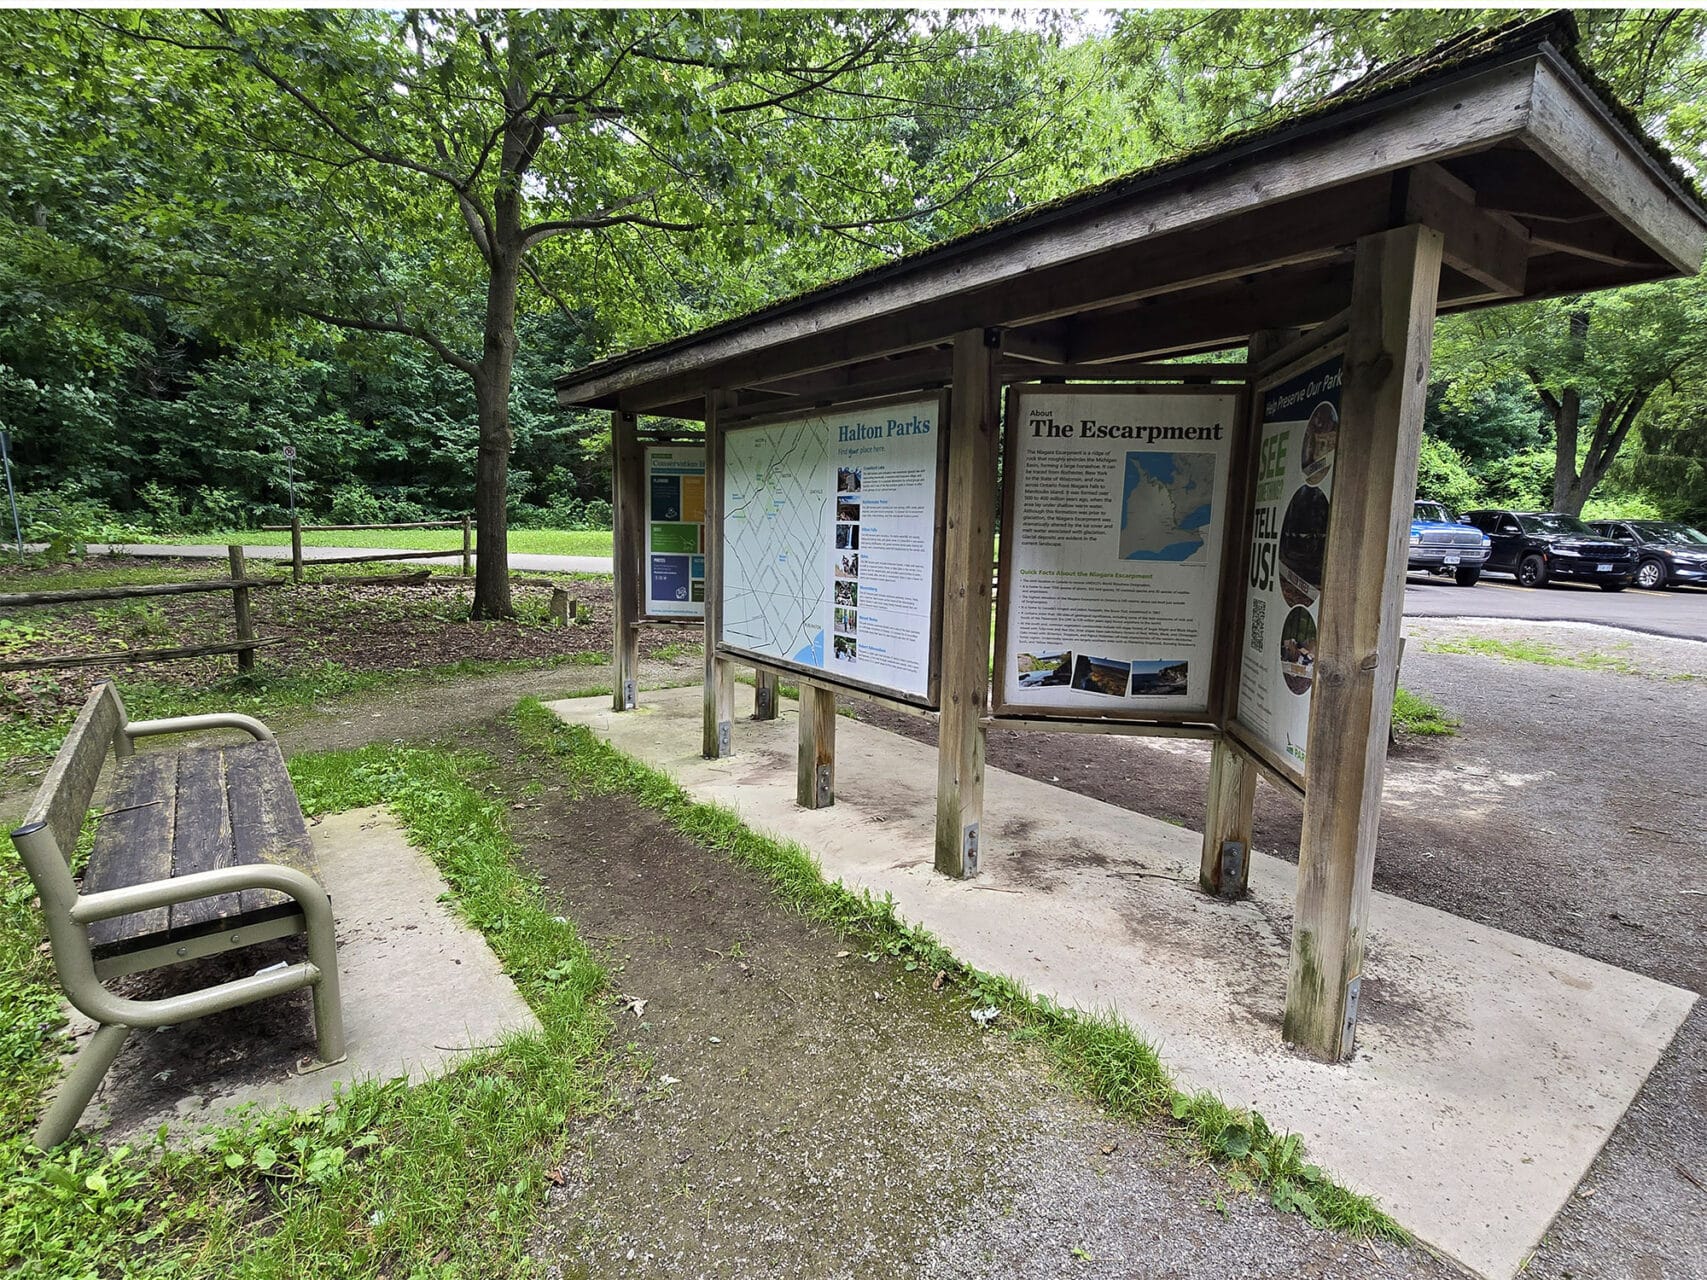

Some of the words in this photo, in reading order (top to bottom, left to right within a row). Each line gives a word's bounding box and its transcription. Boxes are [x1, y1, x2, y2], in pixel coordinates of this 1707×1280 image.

[1278, 388, 1305, 410] Preserve
[1306, 381, 1322, 397] Our
[1322, 367, 1343, 392] Park
[839, 423, 882, 442] Halton
[887, 416, 930, 437] Parks
[1029, 419, 1073, 438] The
[1079, 420, 1223, 443] Escarpment
[860, 447, 872, 455] place
[1260, 430, 1290, 480] SEE
[1254, 506, 1278, 539] TELL
[1250, 542, 1277, 592] US!
